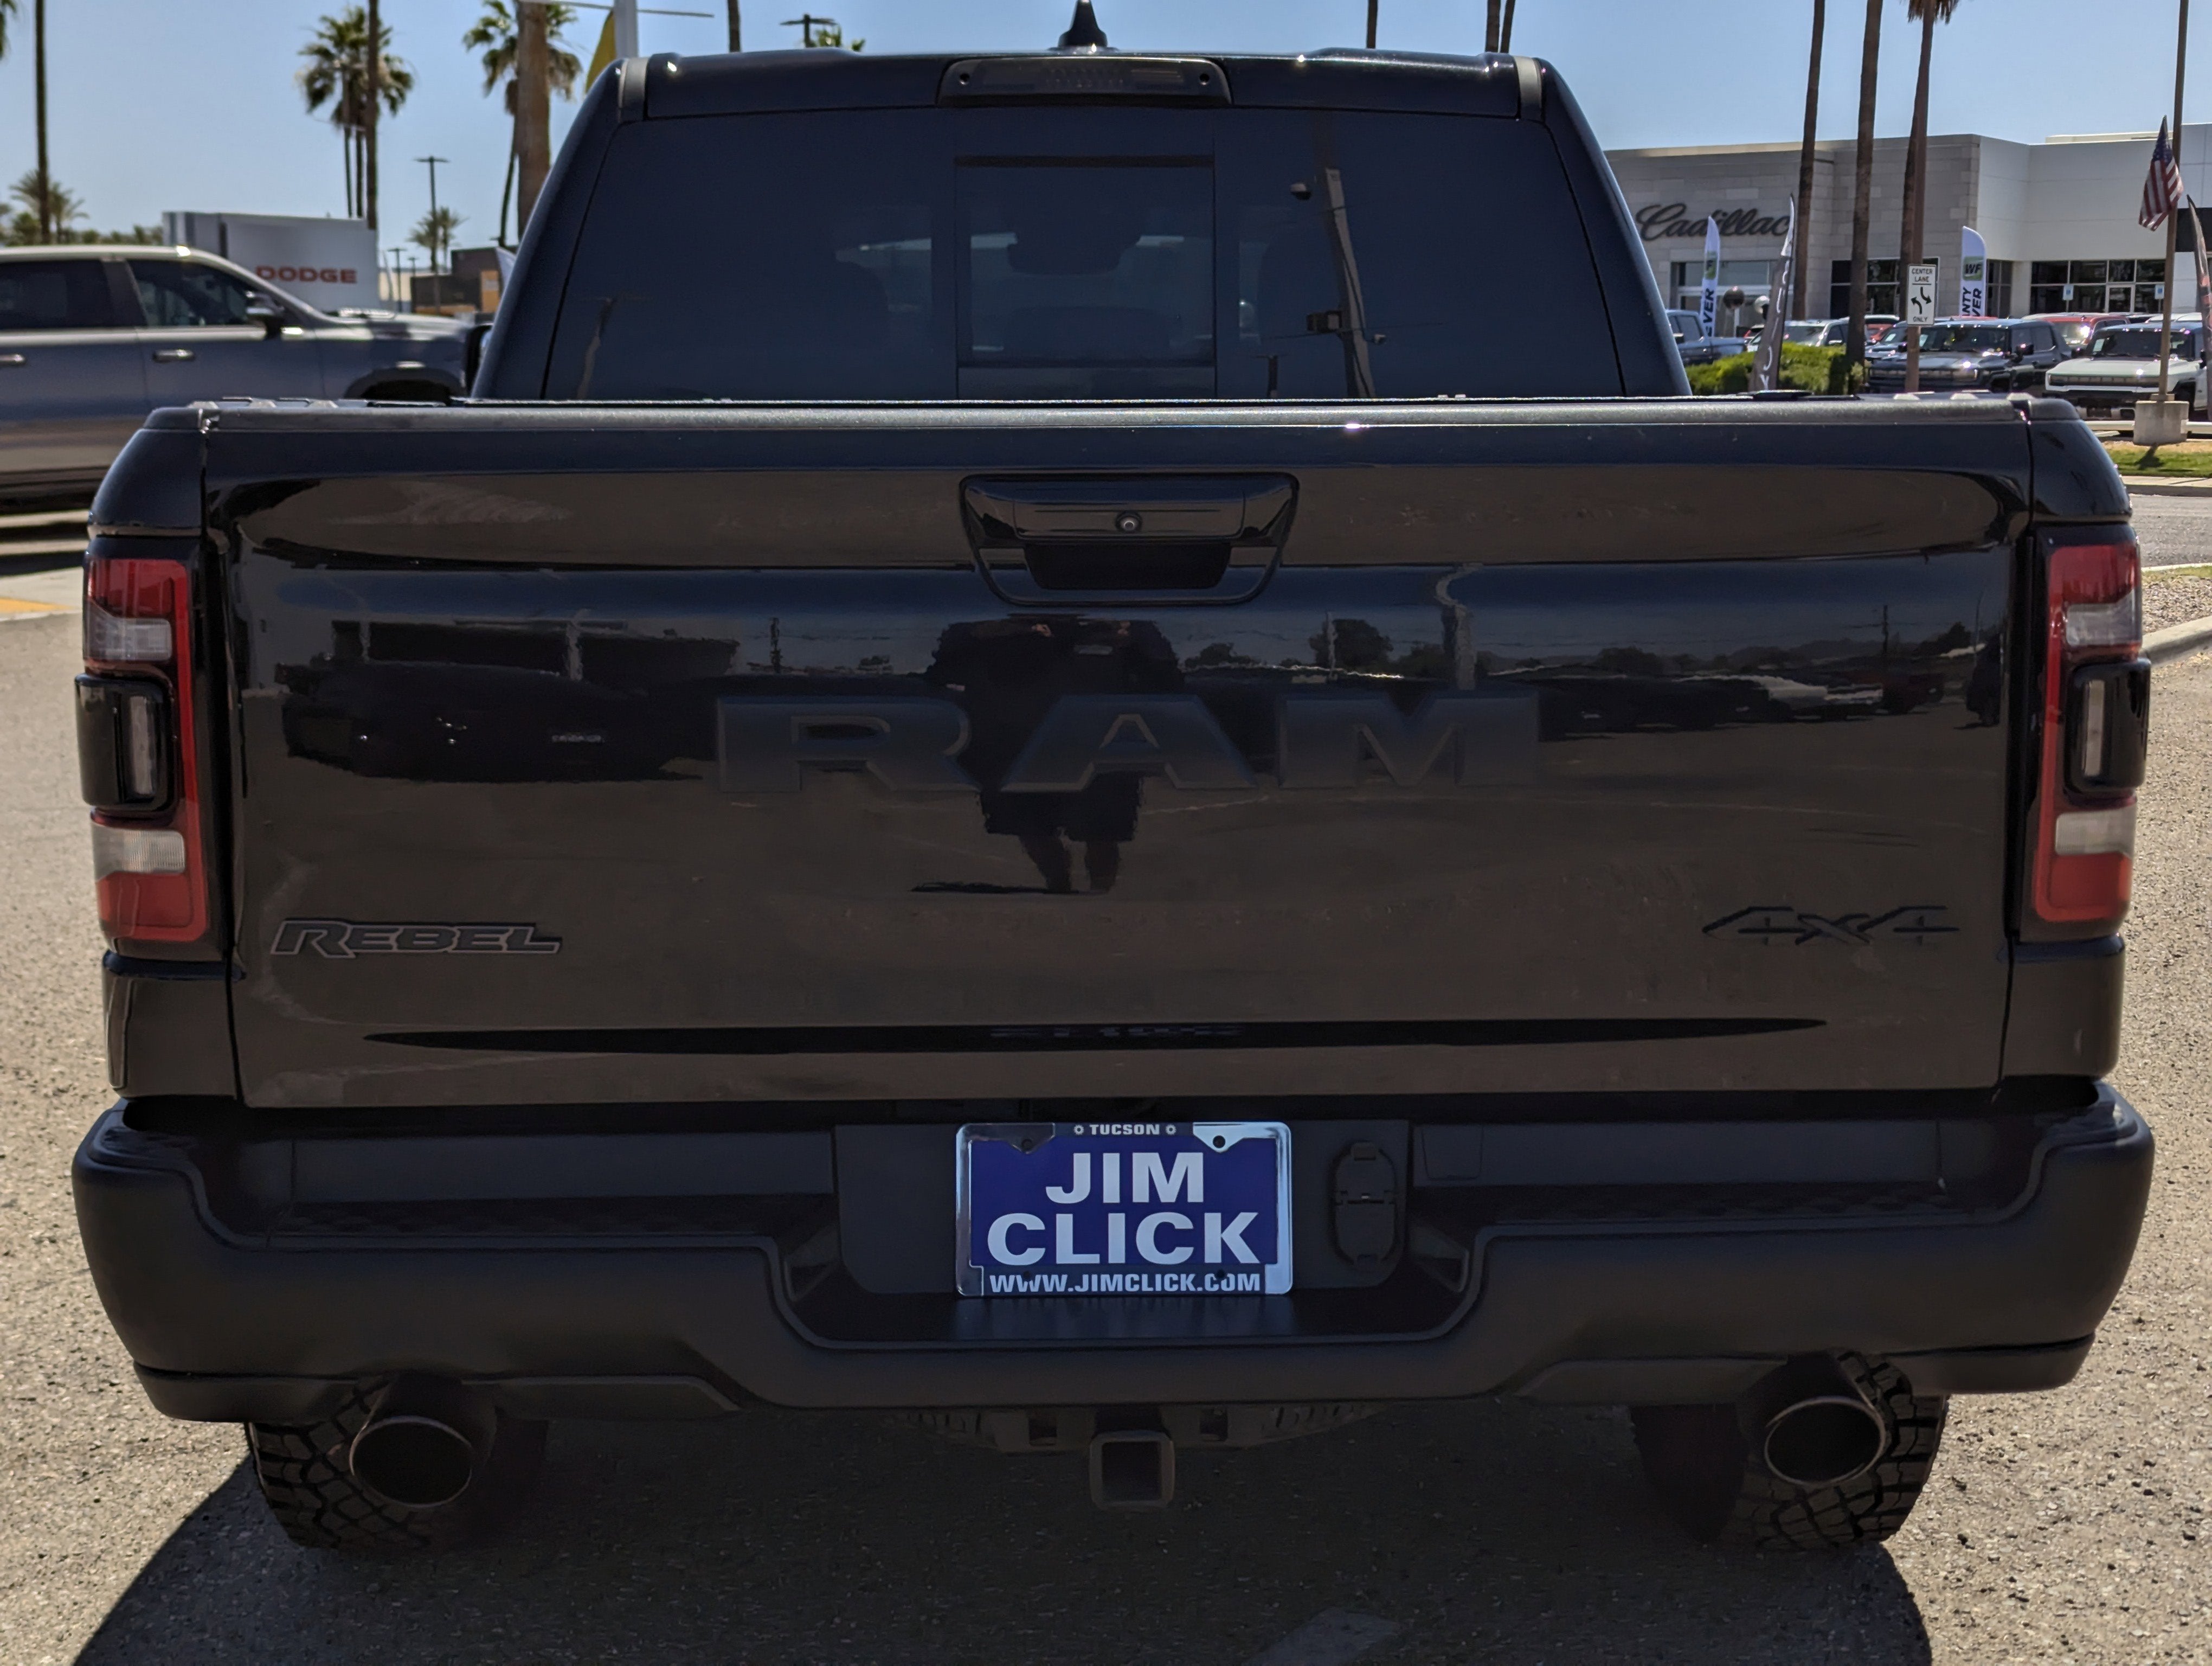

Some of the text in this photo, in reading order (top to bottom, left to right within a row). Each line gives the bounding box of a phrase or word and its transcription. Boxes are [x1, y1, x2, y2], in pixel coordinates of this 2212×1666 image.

[1636, 203, 1790, 241] Cadillac
[256, 266, 357, 284] DODGE
[1962, 287, 1971, 316] NTY
[716, 691, 1540, 793] RAM
[271, 919, 562, 958] REBEL
[1089, 1124, 1160, 1135] TUCSON
[1045, 1152, 1204, 1204] JIM
[987, 1212, 1261, 1266] CLICK
[989, 1273, 1261, 1292] WWW.JIMCLICK.COM
